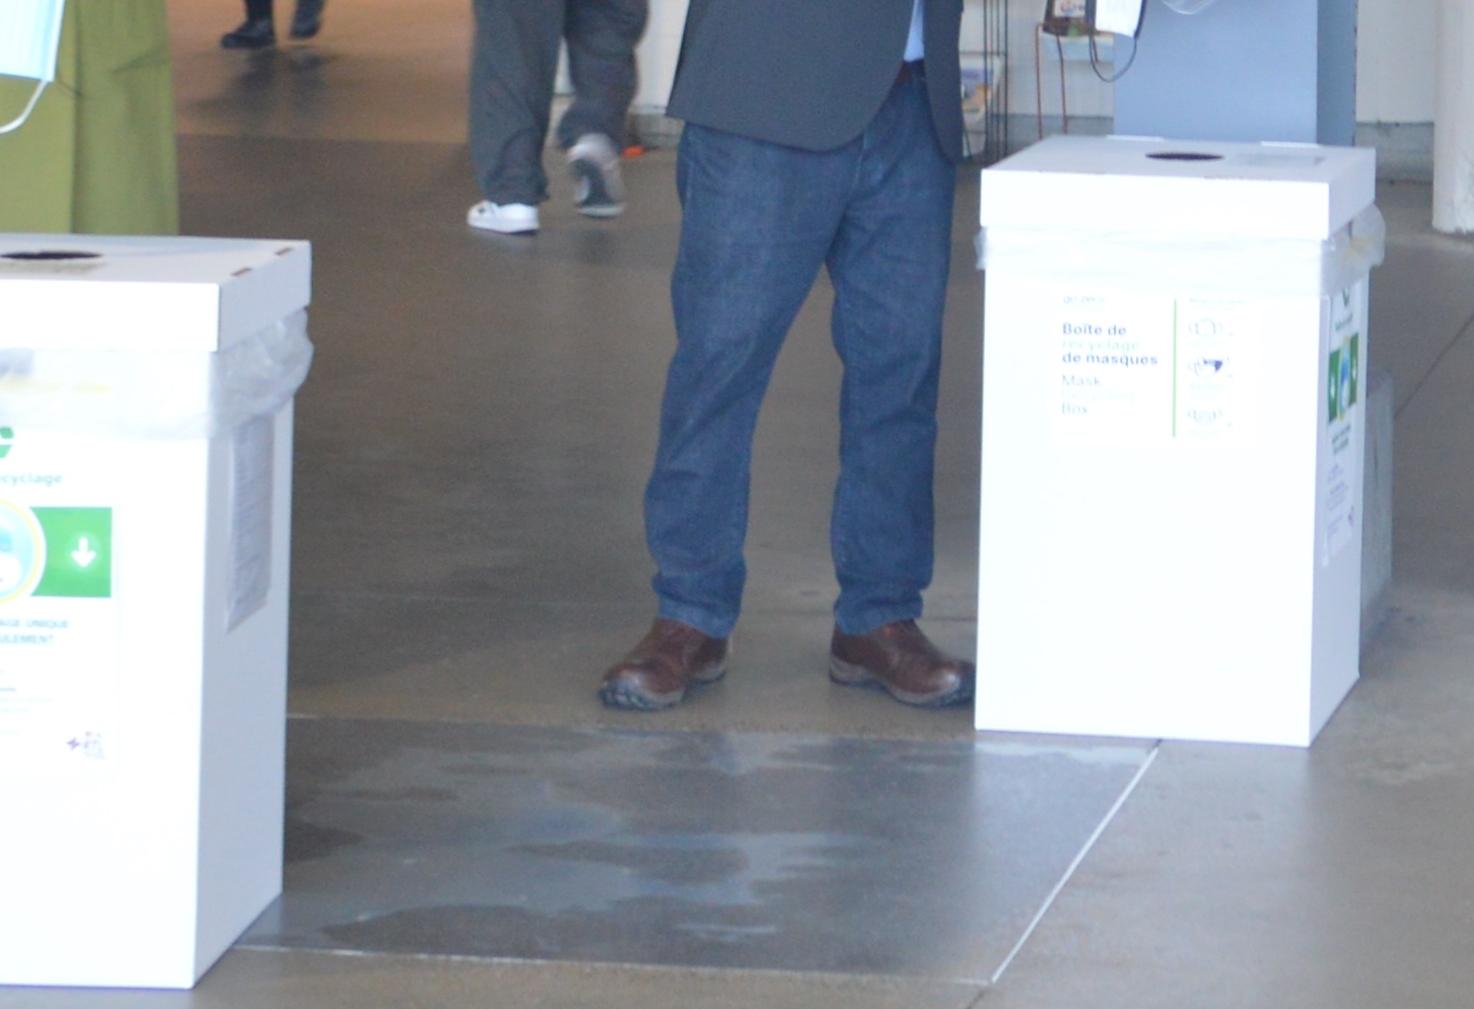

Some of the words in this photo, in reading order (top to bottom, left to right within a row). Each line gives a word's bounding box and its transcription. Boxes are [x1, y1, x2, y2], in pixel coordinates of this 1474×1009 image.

[1062, 321, 1103, 336] Boîte
[1107, 323, 1127, 336] de
[1062, 351, 1081, 364] de
[1086, 354, 1158, 368] masques
[1061, 373, 1101, 387] Mask
